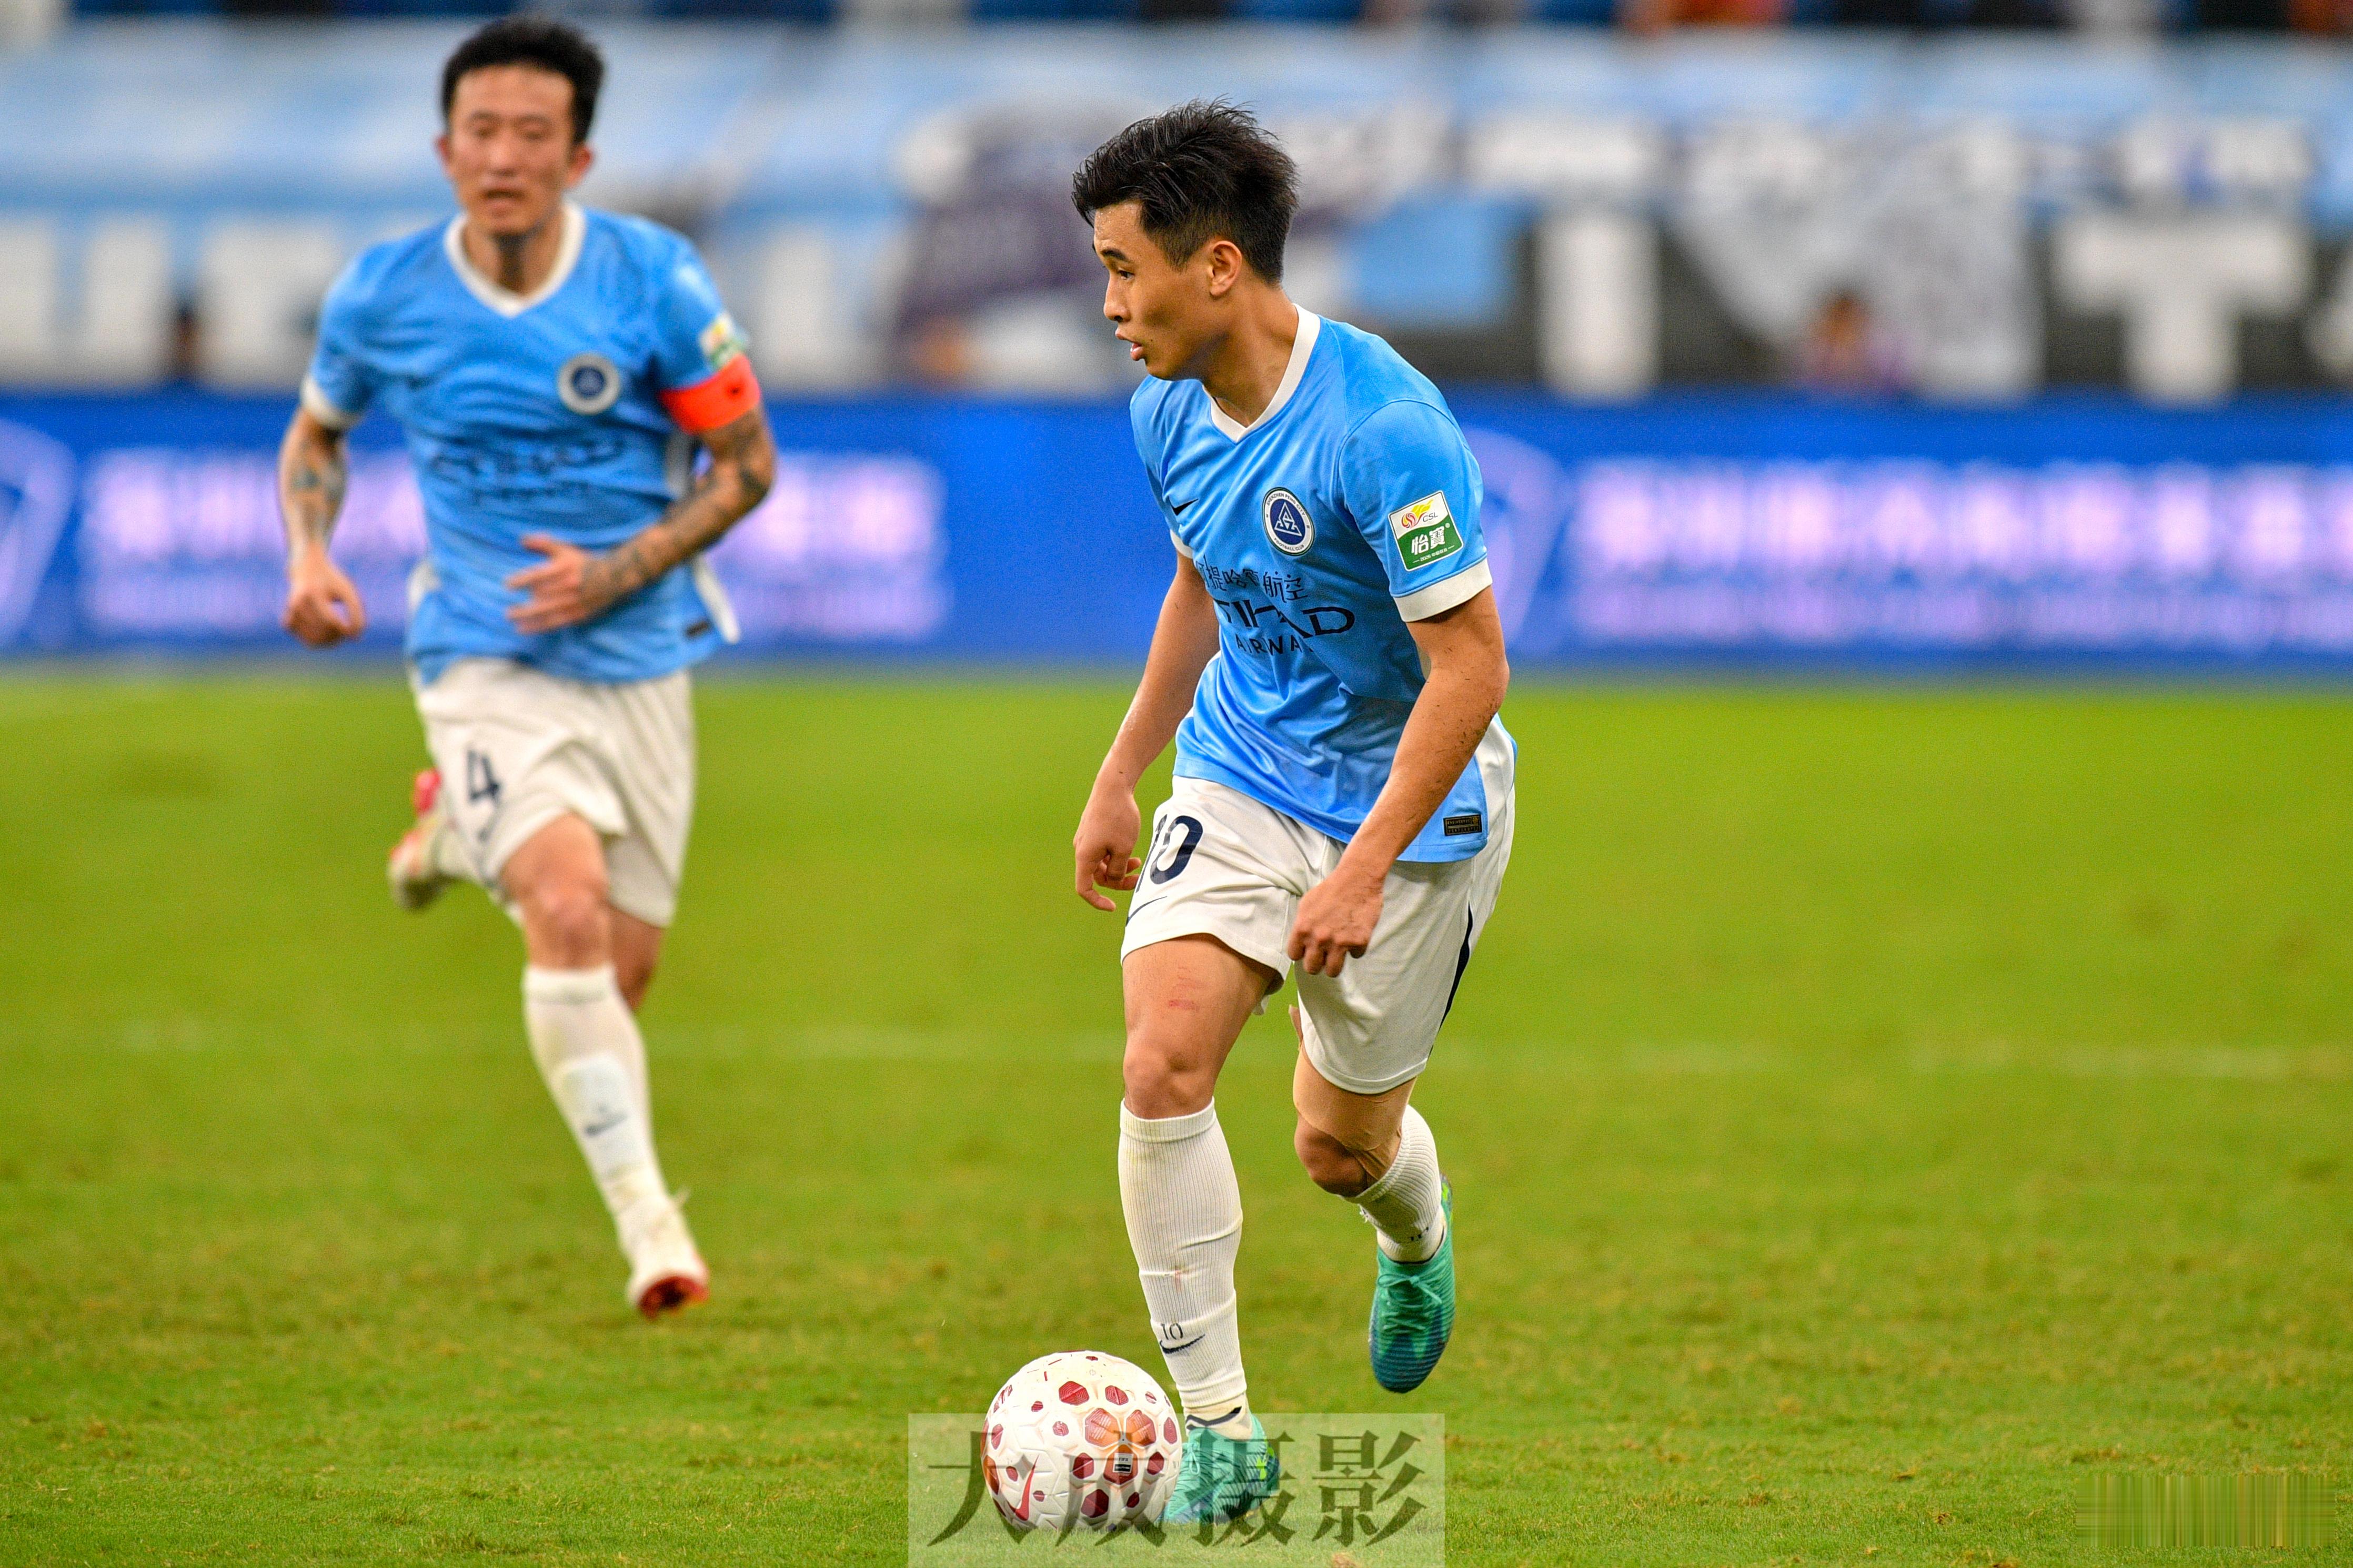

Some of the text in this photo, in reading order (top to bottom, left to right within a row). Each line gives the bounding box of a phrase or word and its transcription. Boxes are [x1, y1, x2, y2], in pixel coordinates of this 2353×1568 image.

[1296, 504, 1305, 515] CITY
[1422, 512, 1438, 522] CSL
[1274, 537, 1295, 551] FOOTBALL
[1411, 526, 1445, 555] 怡寶
[1235, 633, 1314, 656] AIRWA
[467, 747, 502, 812] 4
[1135, 814, 1203, 893] 10
[1160, 1322, 1184, 1340] 10
